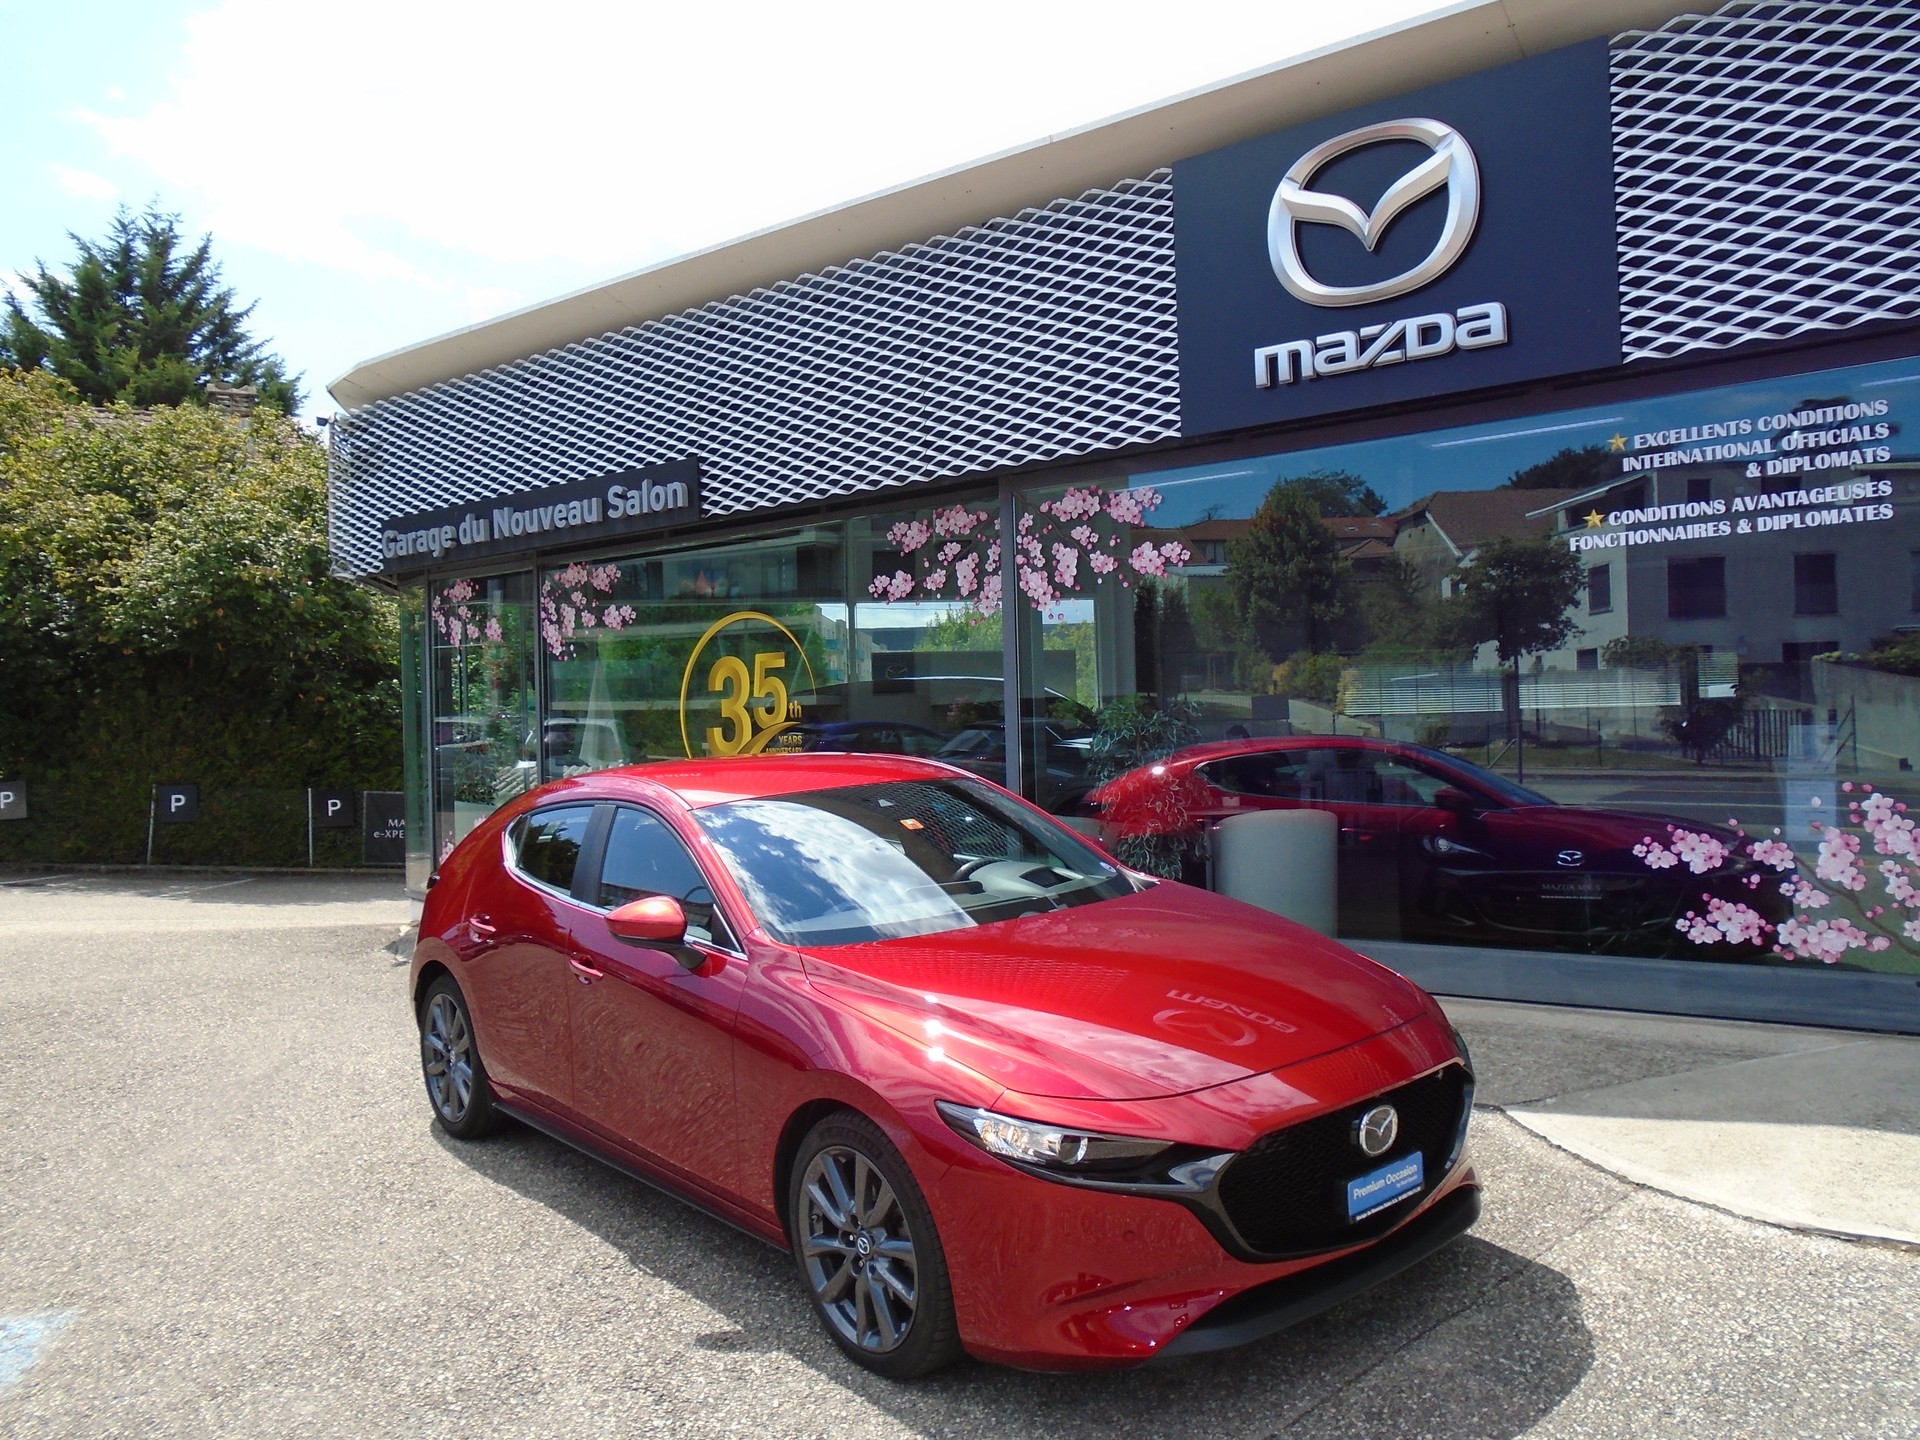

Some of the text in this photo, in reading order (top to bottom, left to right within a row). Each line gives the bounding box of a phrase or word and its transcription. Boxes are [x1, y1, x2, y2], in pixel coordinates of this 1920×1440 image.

[1634, 399, 1888, 449] EXCELLENTS CONDITIONS
[1623, 422, 1889, 472] INTERNATIONAL OFFICIALS
[1746, 446, 1891, 478] & DIPLOMATS
[381, 479, 689, 558] Garage du Nouveau Salon
[1608, 480, 1893, 527] CONDITIONS AVANTAGEUSES
[1569, 503, 1894, 552] FONCTIONNAIRES & DIPLOMATES
[779, 735, 803, 745] YEARS
[0, 791, 14, 809] P
[170, 795, 186, 813] P
[327, 799, 341, 817] P
[1353, 1179, 1386, 1200] Premium
[1385, 1164, 1418, 1185] Occasion
